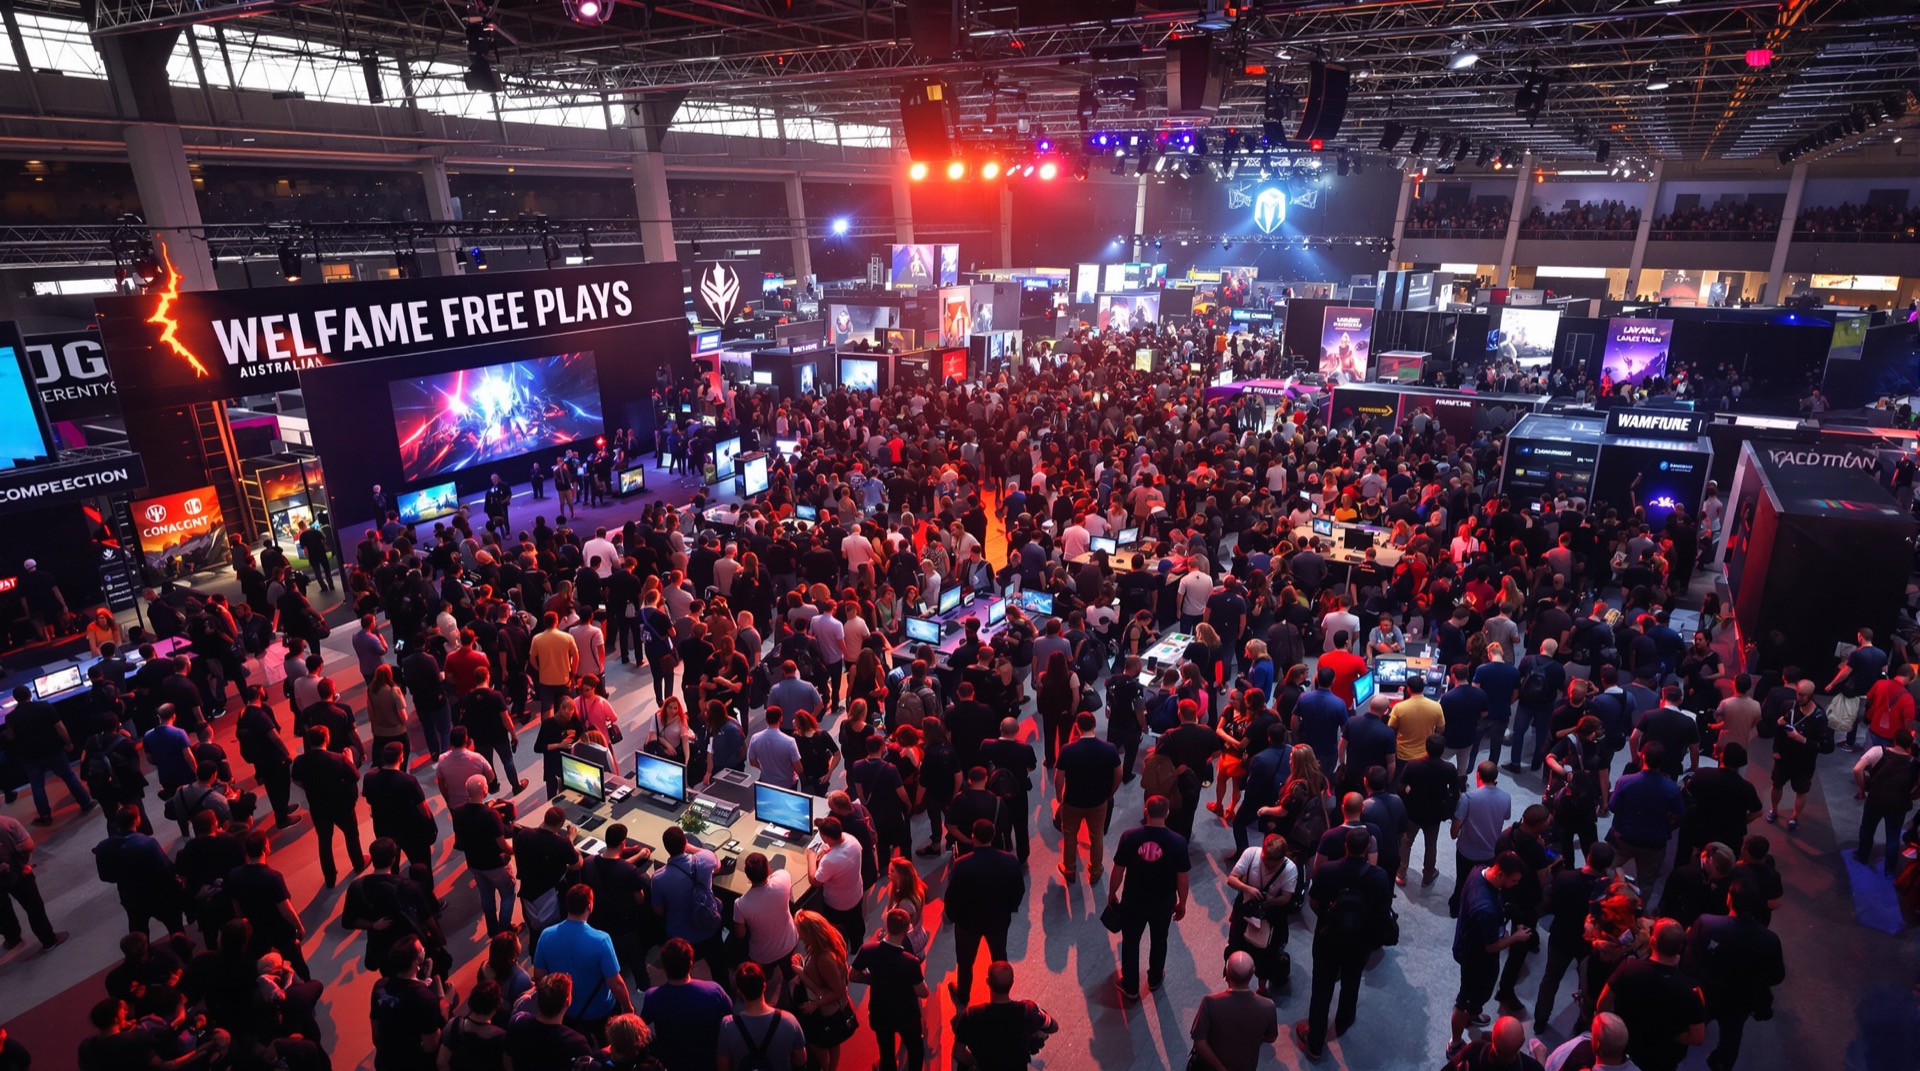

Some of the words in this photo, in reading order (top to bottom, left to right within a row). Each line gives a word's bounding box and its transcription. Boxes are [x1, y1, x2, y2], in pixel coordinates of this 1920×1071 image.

[212, 301, 434, 365] WELFAME
[441, 291, 529, 338] FREE
[534, 281, 632, 327] PLAYS
[40, 381, 117, 402] ERENTYS
